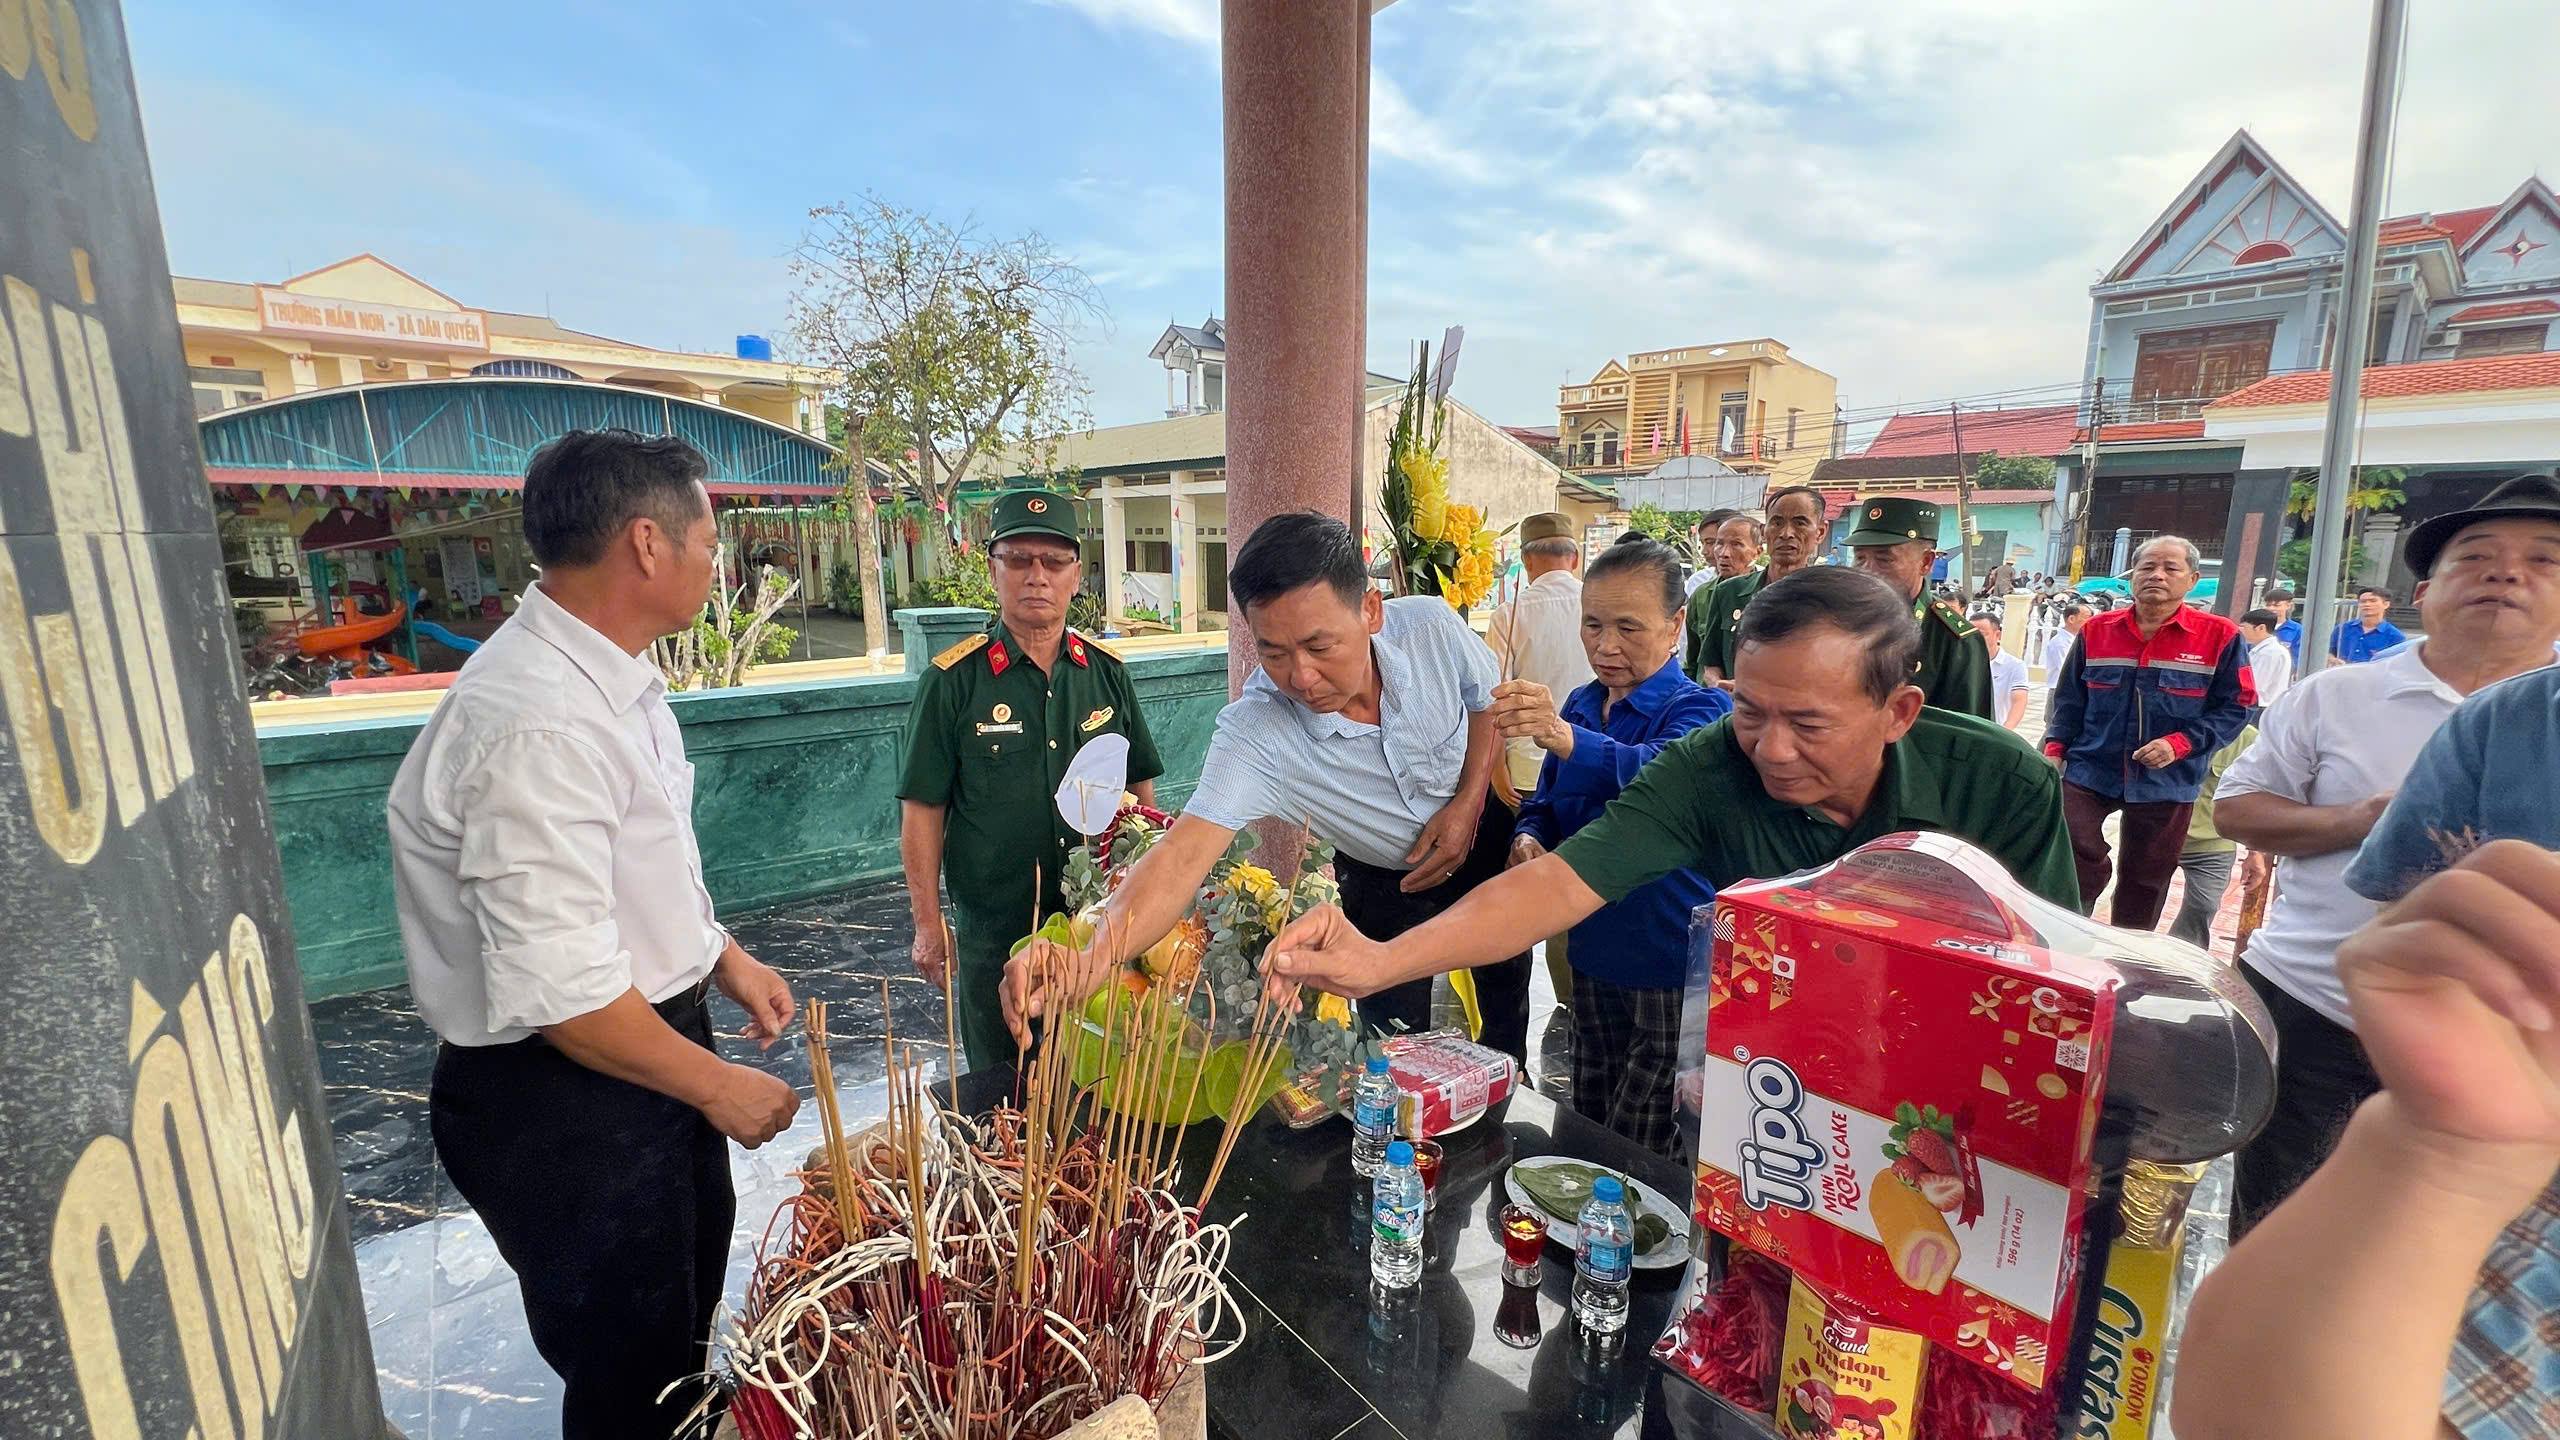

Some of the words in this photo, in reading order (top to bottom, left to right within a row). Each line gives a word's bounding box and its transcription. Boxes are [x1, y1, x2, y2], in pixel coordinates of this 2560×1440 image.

[359, 311, 386, 332] NON
[1738, 1056, 1826, 1212] Tipo
[1832, 1111, 1849, 1160] CAKE
[1834, 1163, 1861, 1212] ROLL
[2012, 1225, 2021, 1239] (14
[2015, 1208, 2024, 1223] oz)
[2007, 1247, 2018, 1266] 396
[1804, 1323, 1890, 1381] London
[1823, 1326, 1870, 1355] Grand
[2126, 1364, 2149, 1422] ORION
